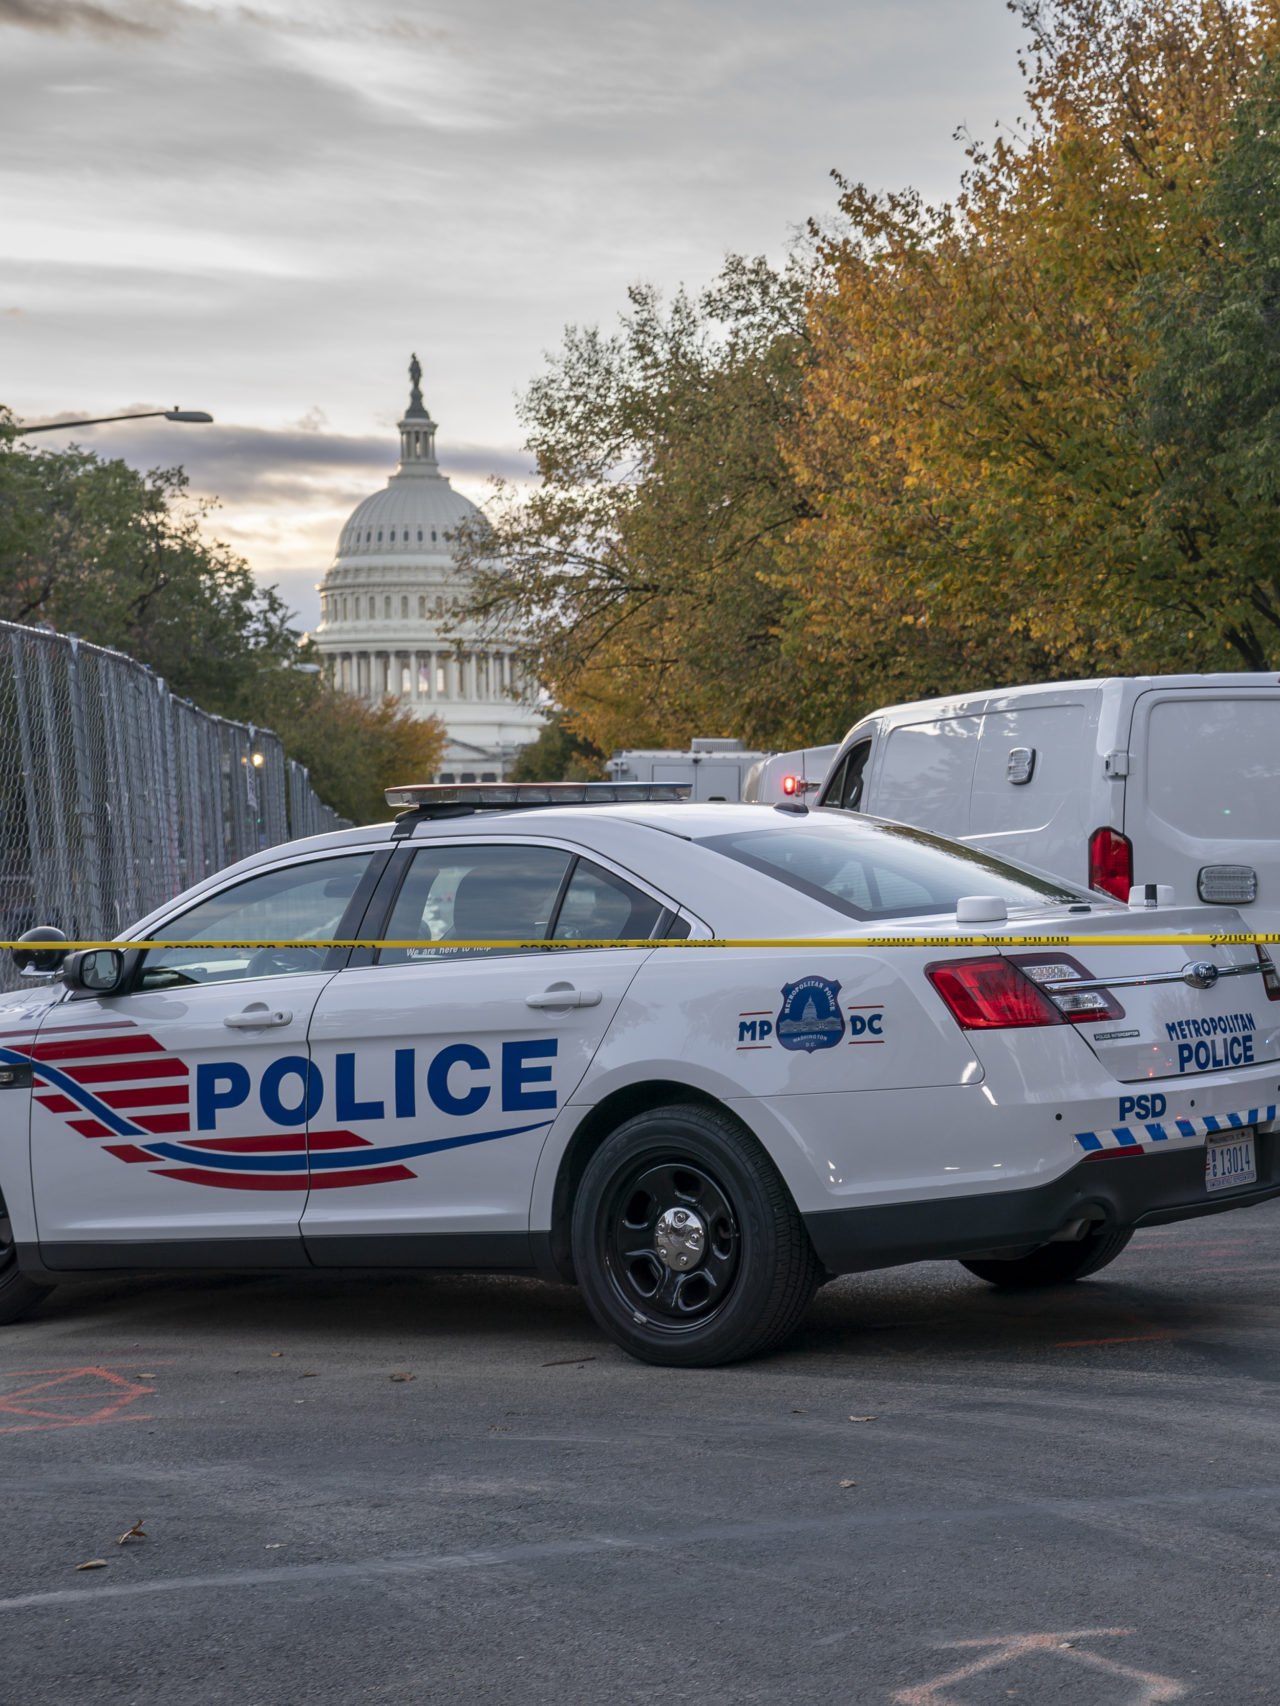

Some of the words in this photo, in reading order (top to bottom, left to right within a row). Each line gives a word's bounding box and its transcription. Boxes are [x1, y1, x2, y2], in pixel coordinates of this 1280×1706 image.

[406, 948, 419, 956] We
[784, 980, 824, 1014] METROPOLITAN
[823, 986, 836, 1012] POLICE
[737, 1019, 773, 1042] MP
[792, 1034, 828, 1043] WASHINGTON
[851, 1013, 883, 1037] DC
[1165, 1012, 1257, 1041] METROPOLITAN
[1178, 1034, 1255, 1073] POLICE
[196, 1038, 558, 1131] POLICE
[1119, 1093, 1167, 1121] PSD
[1220, 1144, 1251, 1176] 13014
